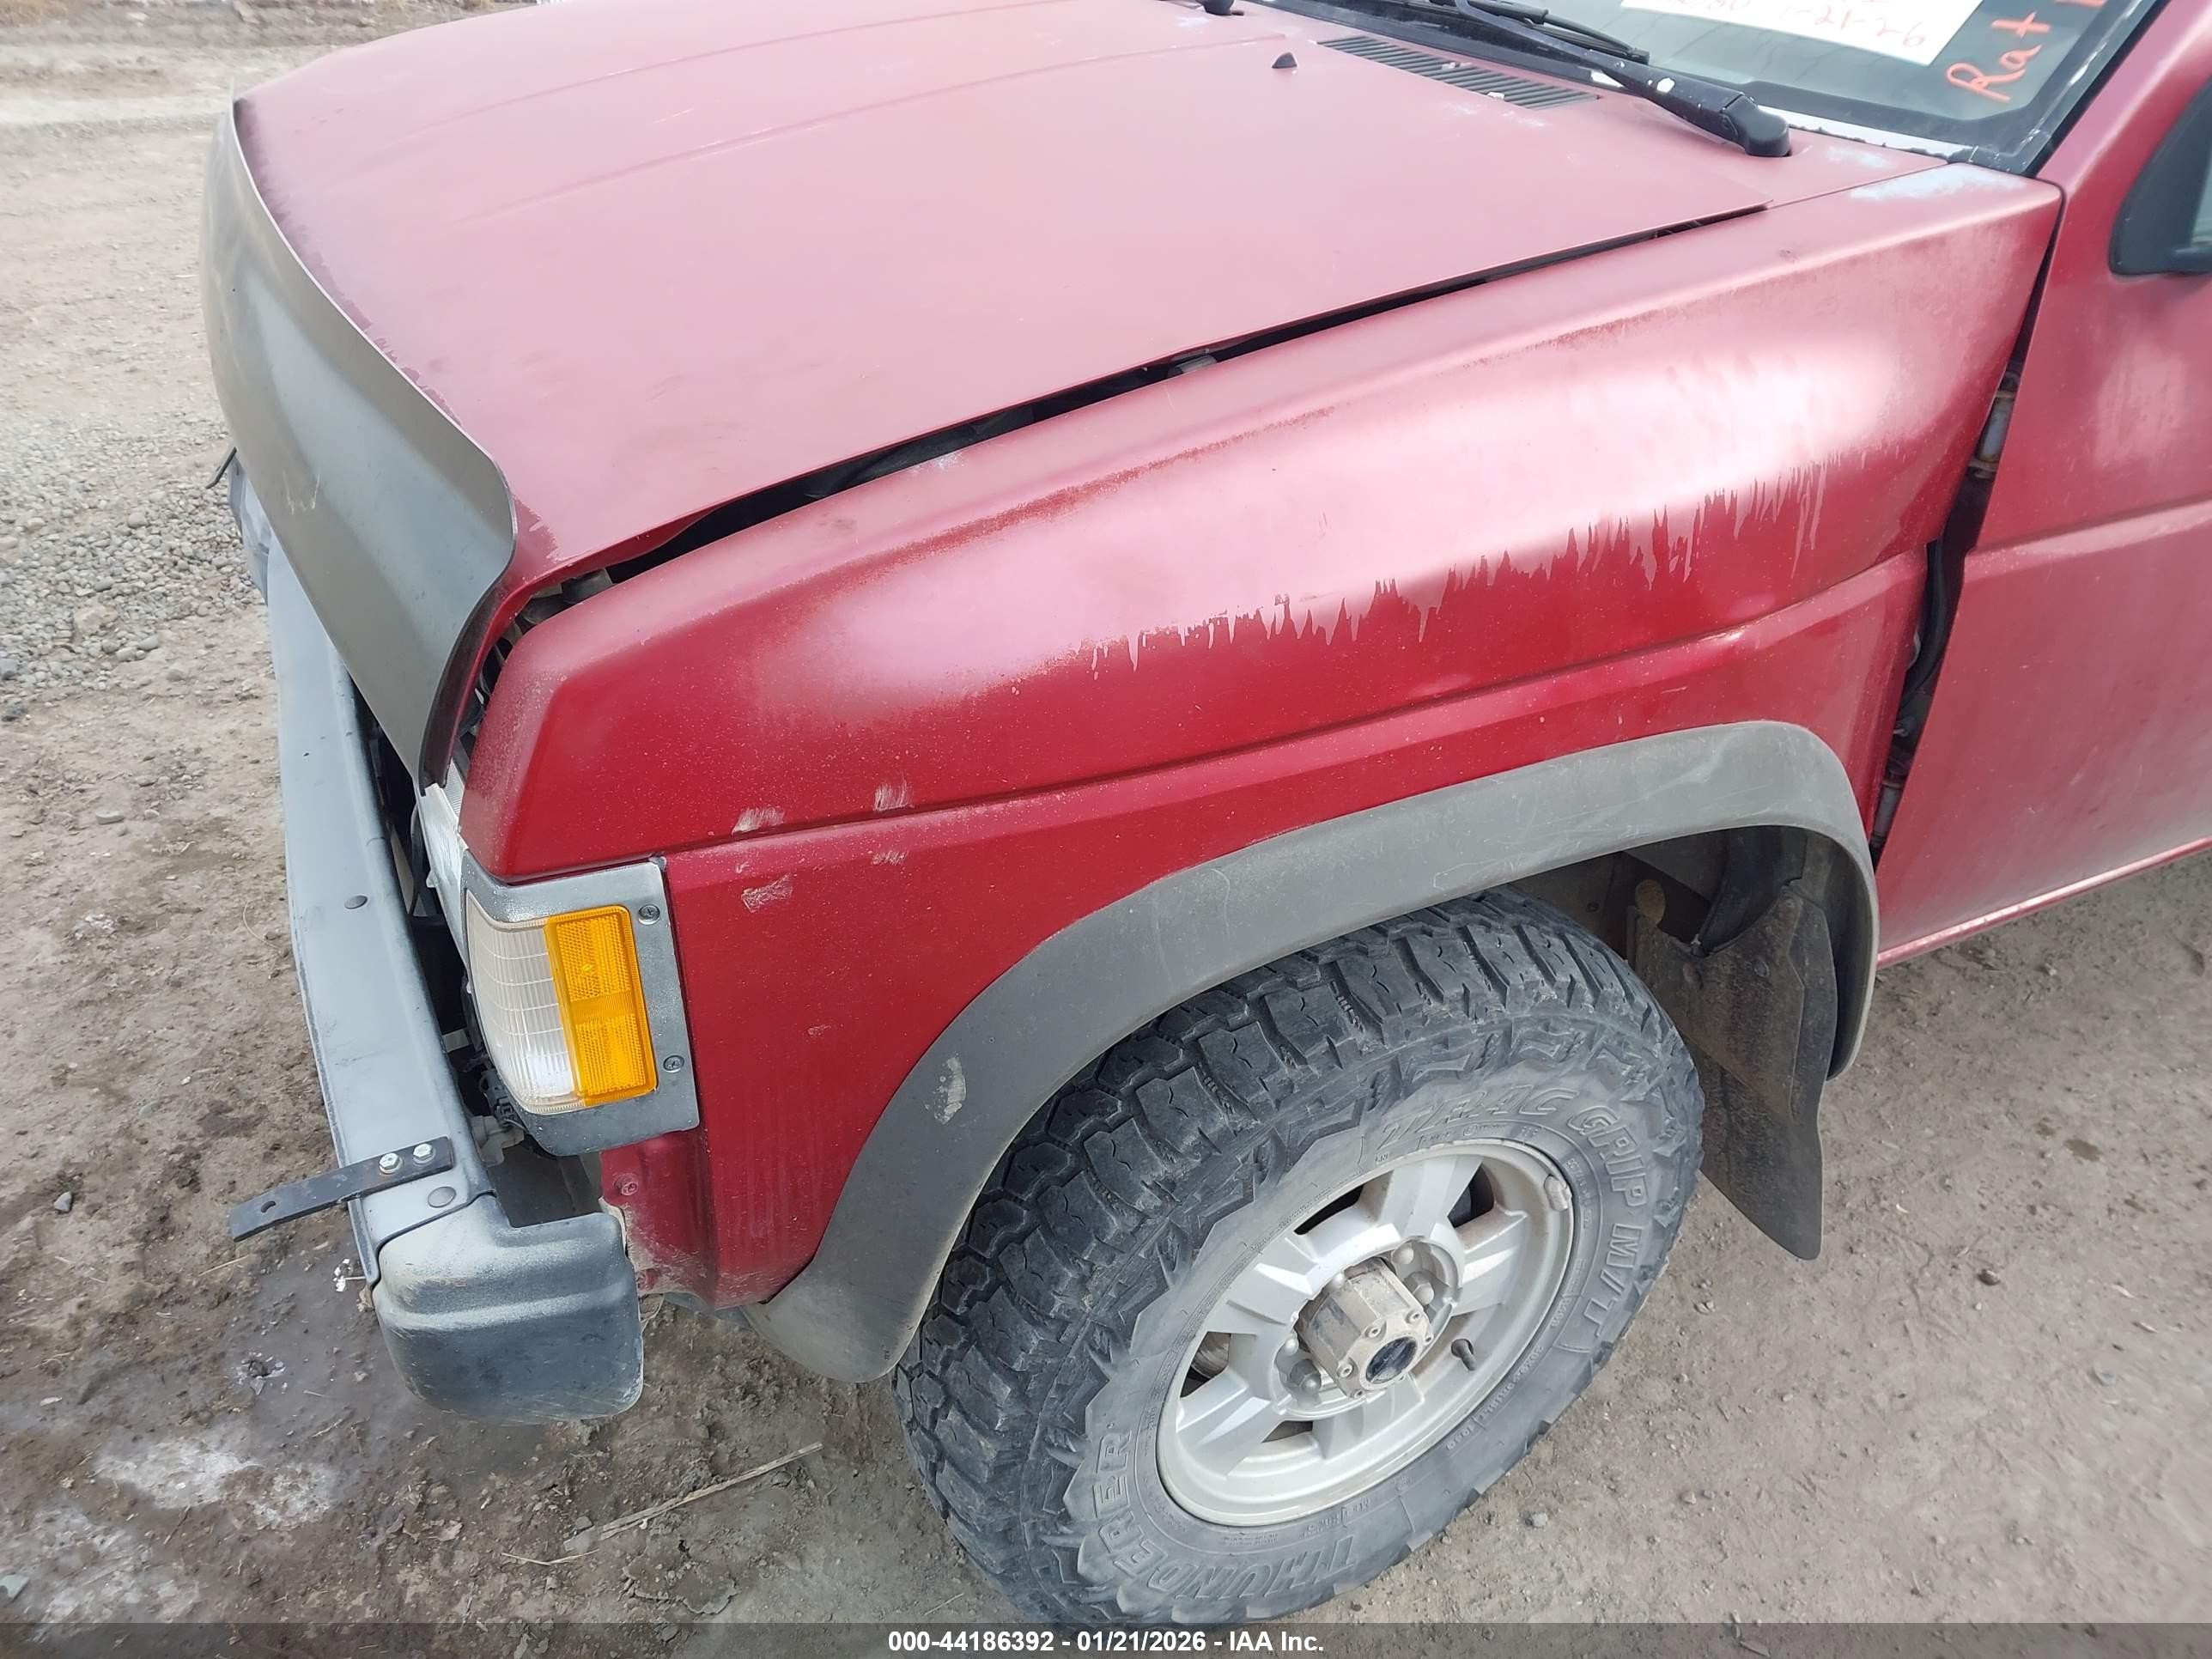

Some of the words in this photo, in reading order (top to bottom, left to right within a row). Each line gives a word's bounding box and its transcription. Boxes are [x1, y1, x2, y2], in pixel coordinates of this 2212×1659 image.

[1566, 1104, 1650, 1207] GRIP
[1583, 1223, 1643, 1338] M/T
[1091, 1429, 1356, 1601] THUNDERER
